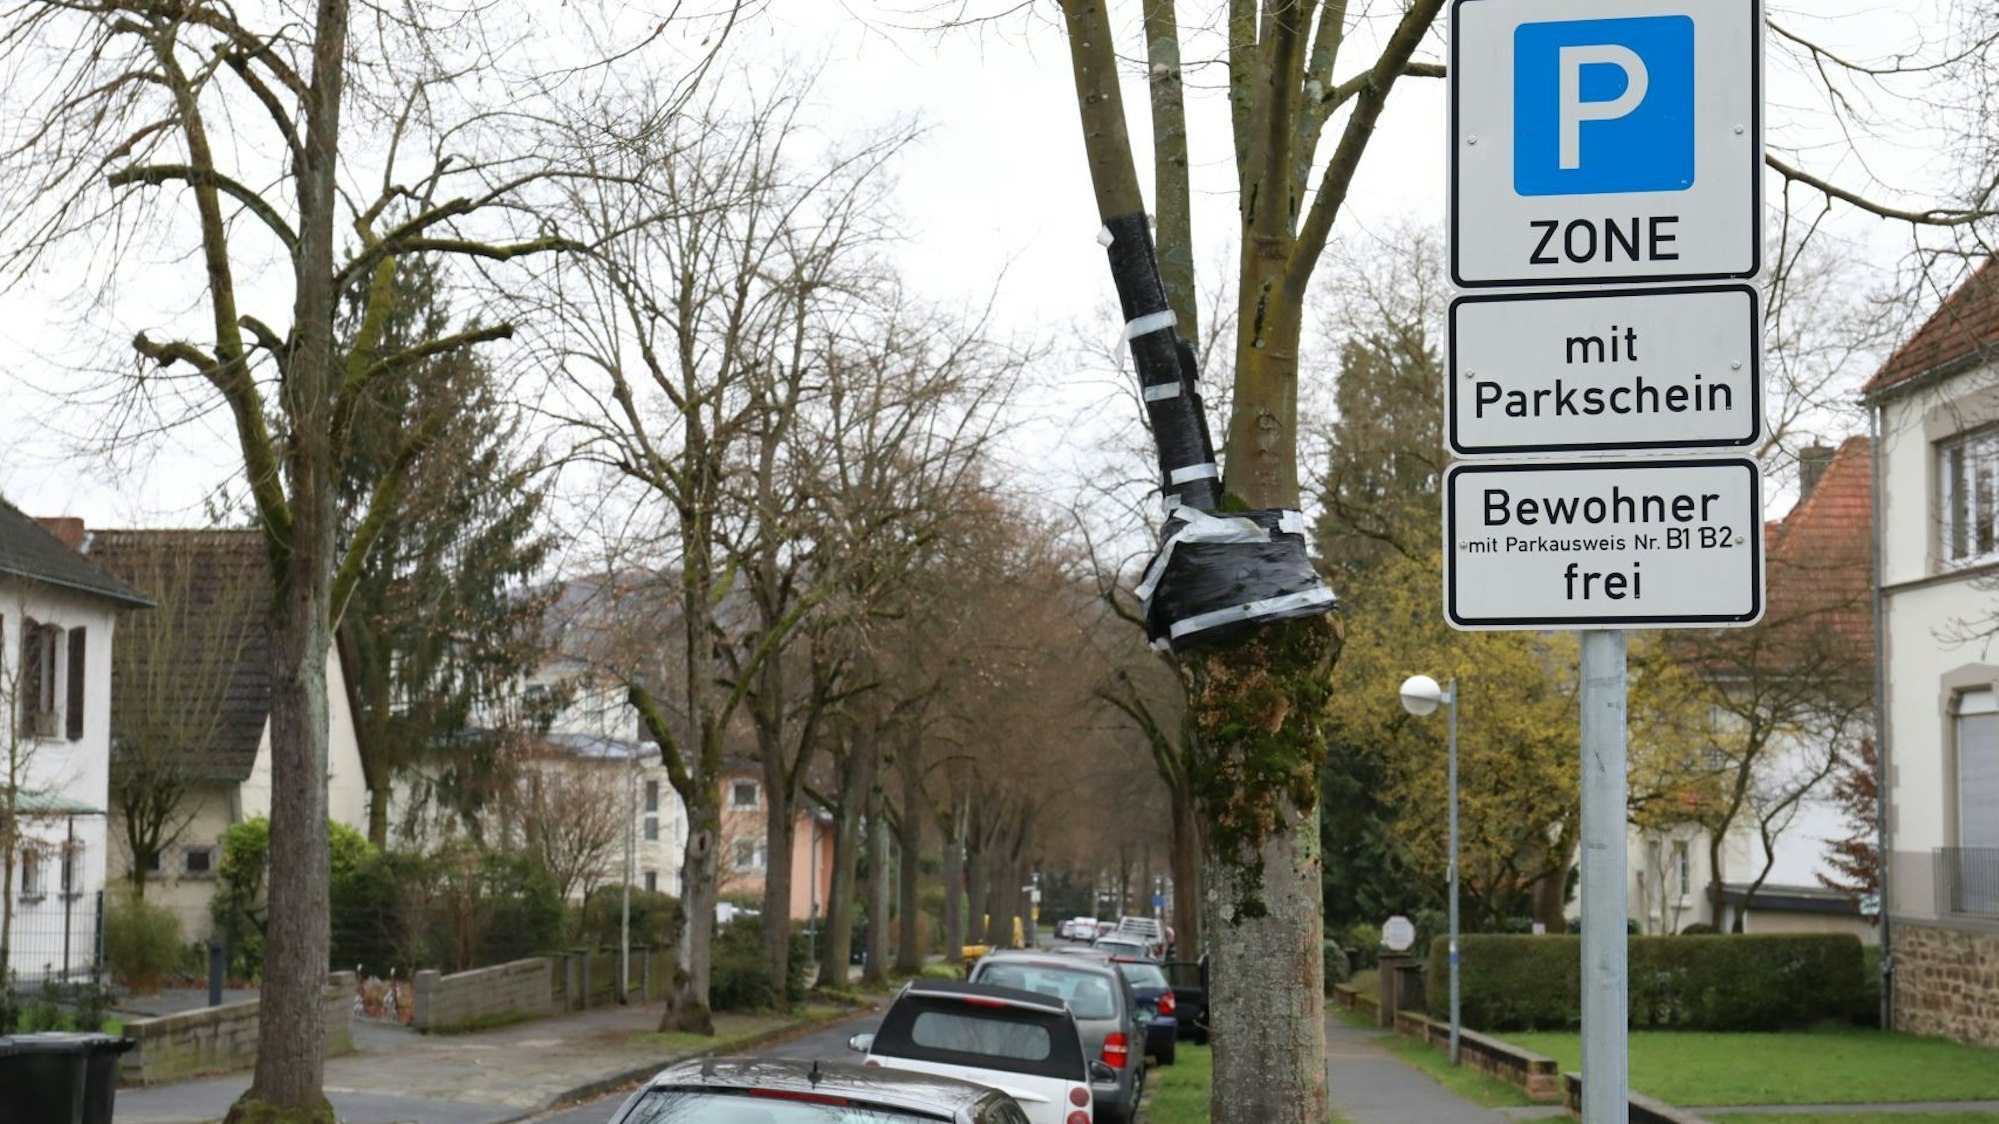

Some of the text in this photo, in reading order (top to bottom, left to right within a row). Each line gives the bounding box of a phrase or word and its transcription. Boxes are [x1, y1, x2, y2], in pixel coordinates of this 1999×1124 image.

[1559, 44, 1649, 170] P
[1529, 215, 1680, 264] ZONE
[1566, 325, 1638, 364] mit
[1475, 374, 1732, 419] Parkschein
[1484, 486, 1721, 527] Bewohner
[1469, 525, 1733, 553] mit Parkausweis Nr. B1 B2
[1564, 561, 1641, 600] frei
